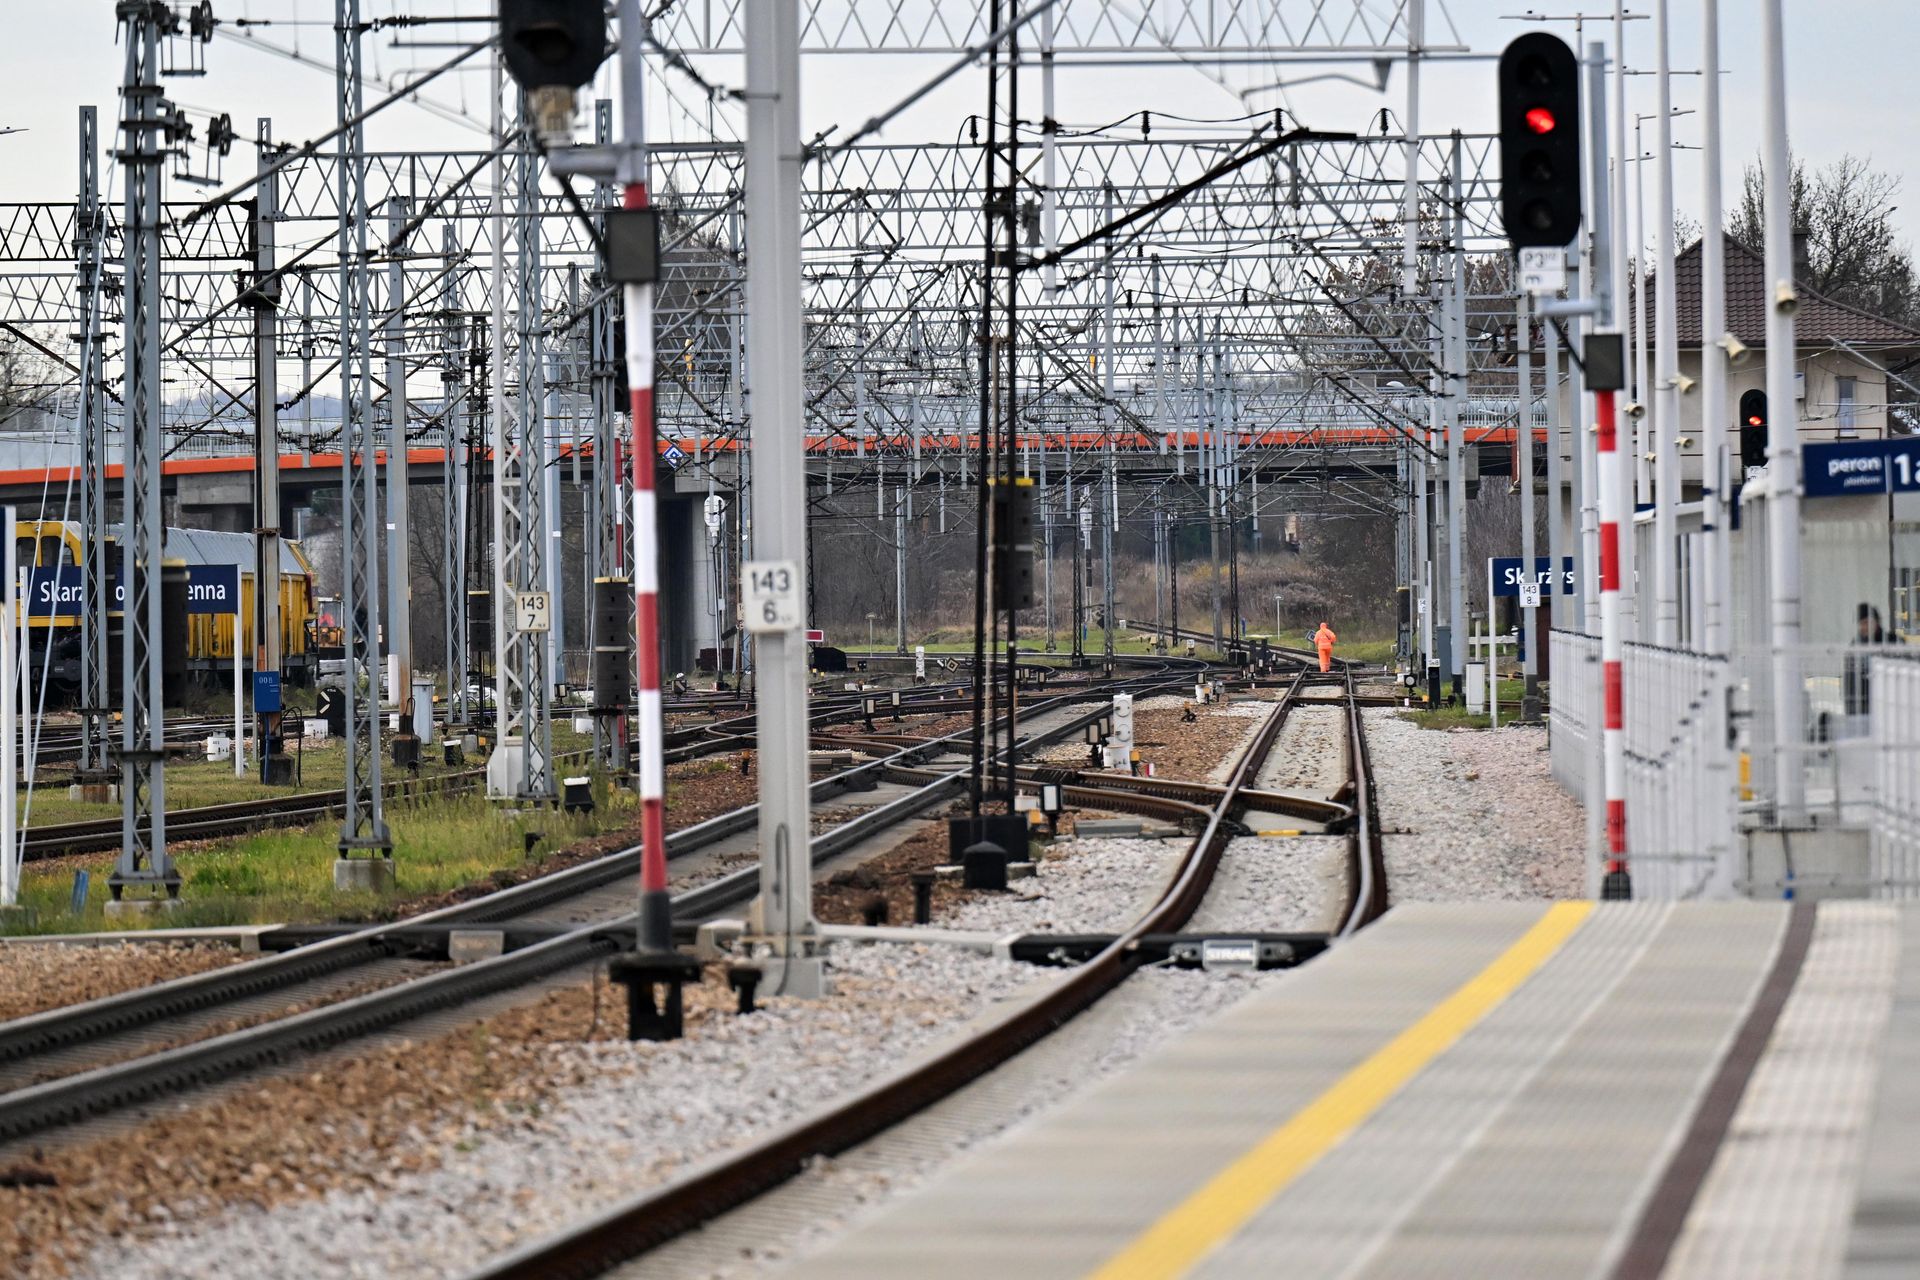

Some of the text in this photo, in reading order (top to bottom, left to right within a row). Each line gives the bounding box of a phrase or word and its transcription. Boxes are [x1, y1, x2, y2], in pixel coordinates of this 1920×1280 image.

[1828, 457, 1882, 477] peron
[752, 568, 790, 593] 143
[1522, 585, 1537, 594] 143
[521, 596, 544, 610] 143
[1526, 596, 1532, 604] 8
[763, 600, 777, 624] 6
[527, 613, 536, 628] 7
